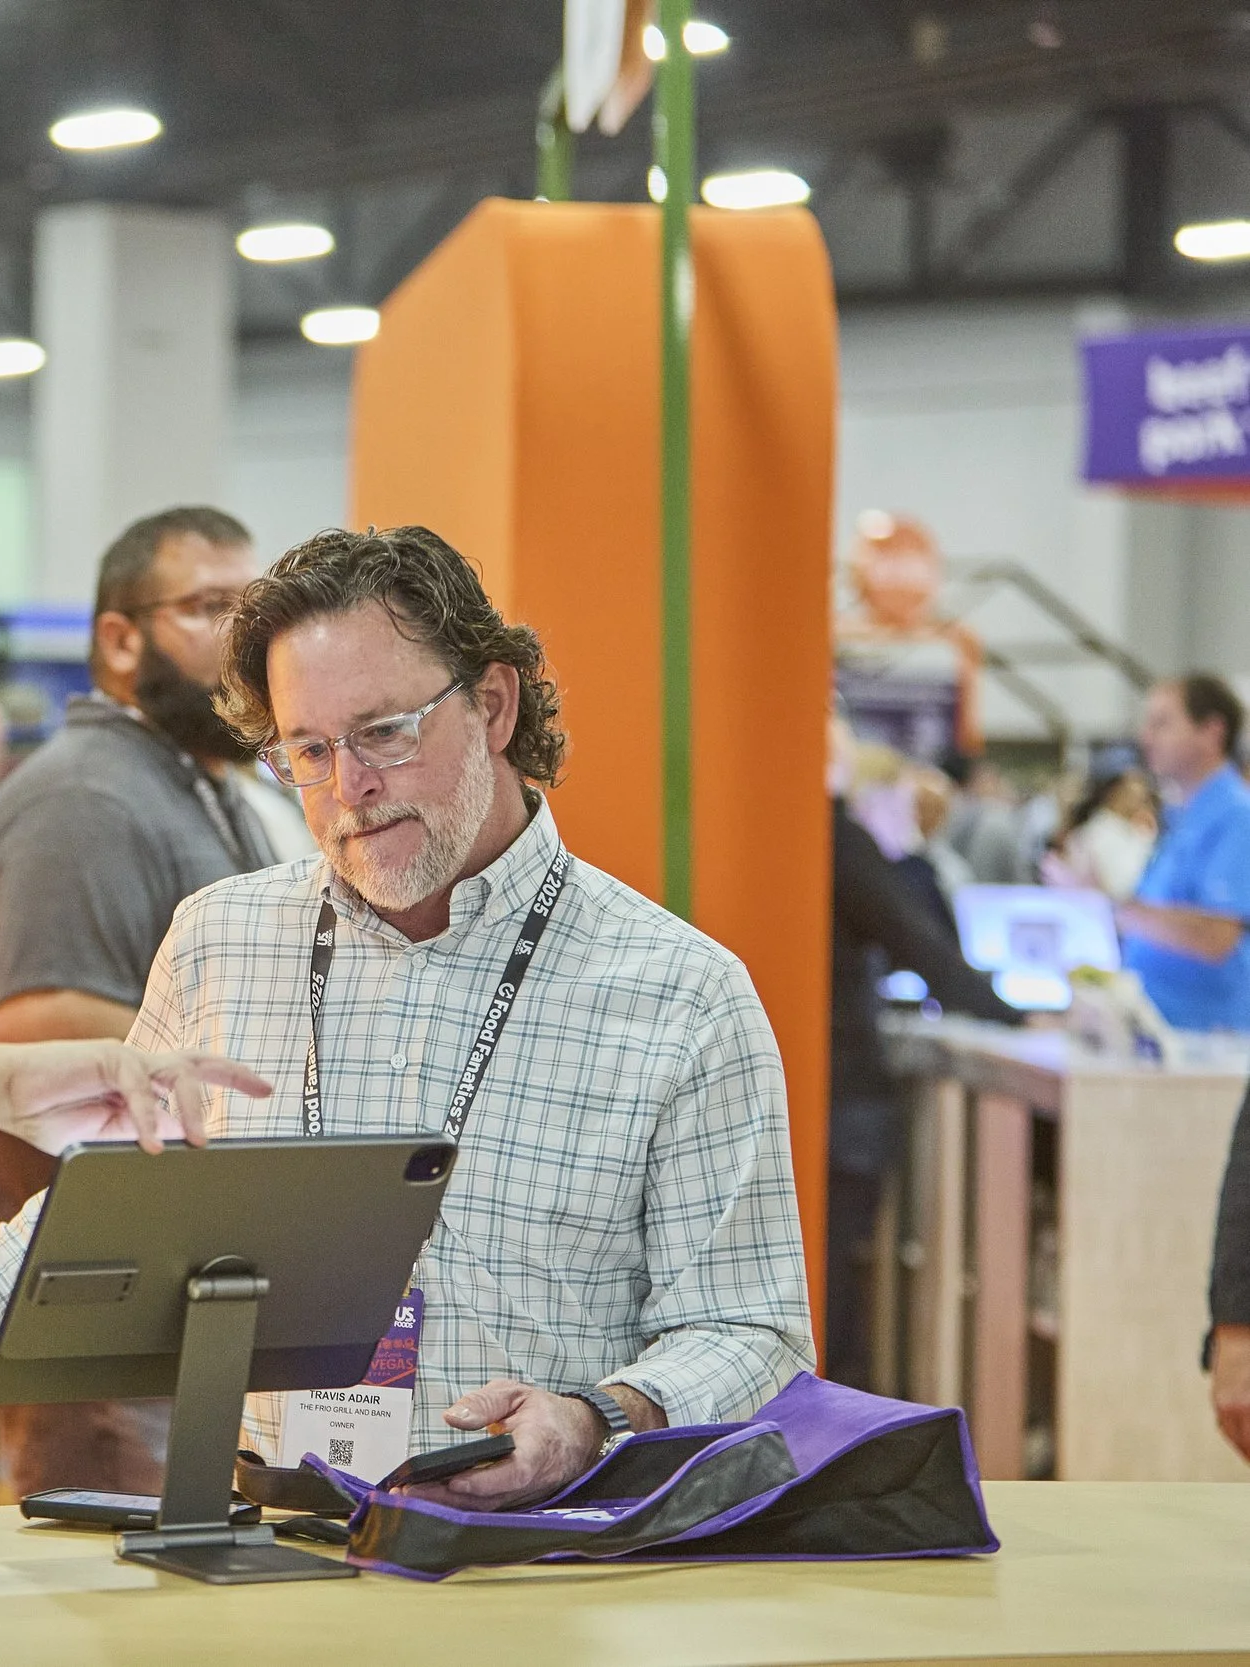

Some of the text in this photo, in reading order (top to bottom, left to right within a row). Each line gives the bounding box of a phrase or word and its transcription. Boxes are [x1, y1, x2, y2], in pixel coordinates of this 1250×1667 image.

[533, 873, 562, 917] 2025
[479, 999, 509, 1044] Food
[305, 1098, 321, 1137] ood
[370, 1358, 414, 1371] VEGAS
[310, 1389, 381, 1405] TRAVIS ADAIR
[300, 1403, 392, 1418] THE FRIO GRILL AND BARN
[329, 1420, 355, 1430] OWNER
